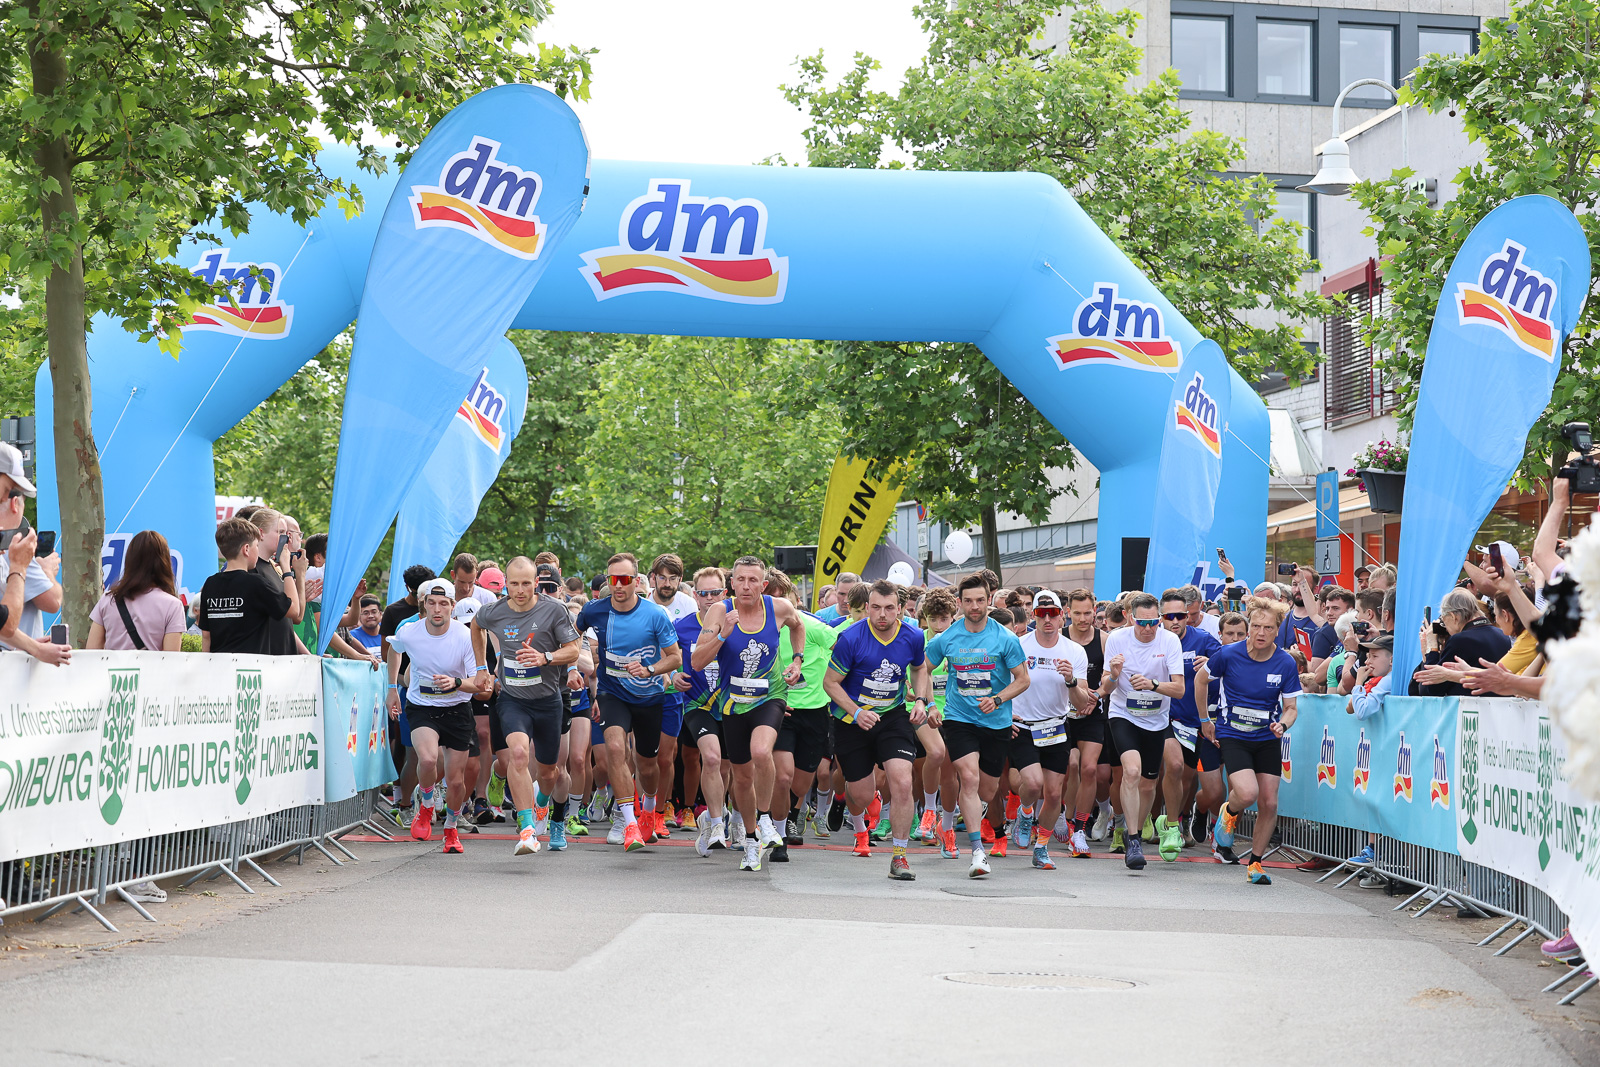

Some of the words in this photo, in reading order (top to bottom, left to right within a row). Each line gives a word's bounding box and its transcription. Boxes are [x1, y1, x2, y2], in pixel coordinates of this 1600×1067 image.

[444, 142, 537, 217] dm
[628, 184, 759, 255] dm
[1482, 246, 1553, 320] dm
[1078, 288, 1160, 339] dm
[1186, 376, 1216, 429] dm
[141, 696, 162, 727] Kreis-
[172, 695, 232, 726] Universitätsstadt
[870, 689, 890, 697] Jeremy
[135, 740, 231, 793] HOMBURG
[260, 732, 319, 779] HOMBURG
[1321, 728, 1335, 764] dm
[1357, 731, 1371, 769] dm
[1397, 735, 1411, 775] dm
